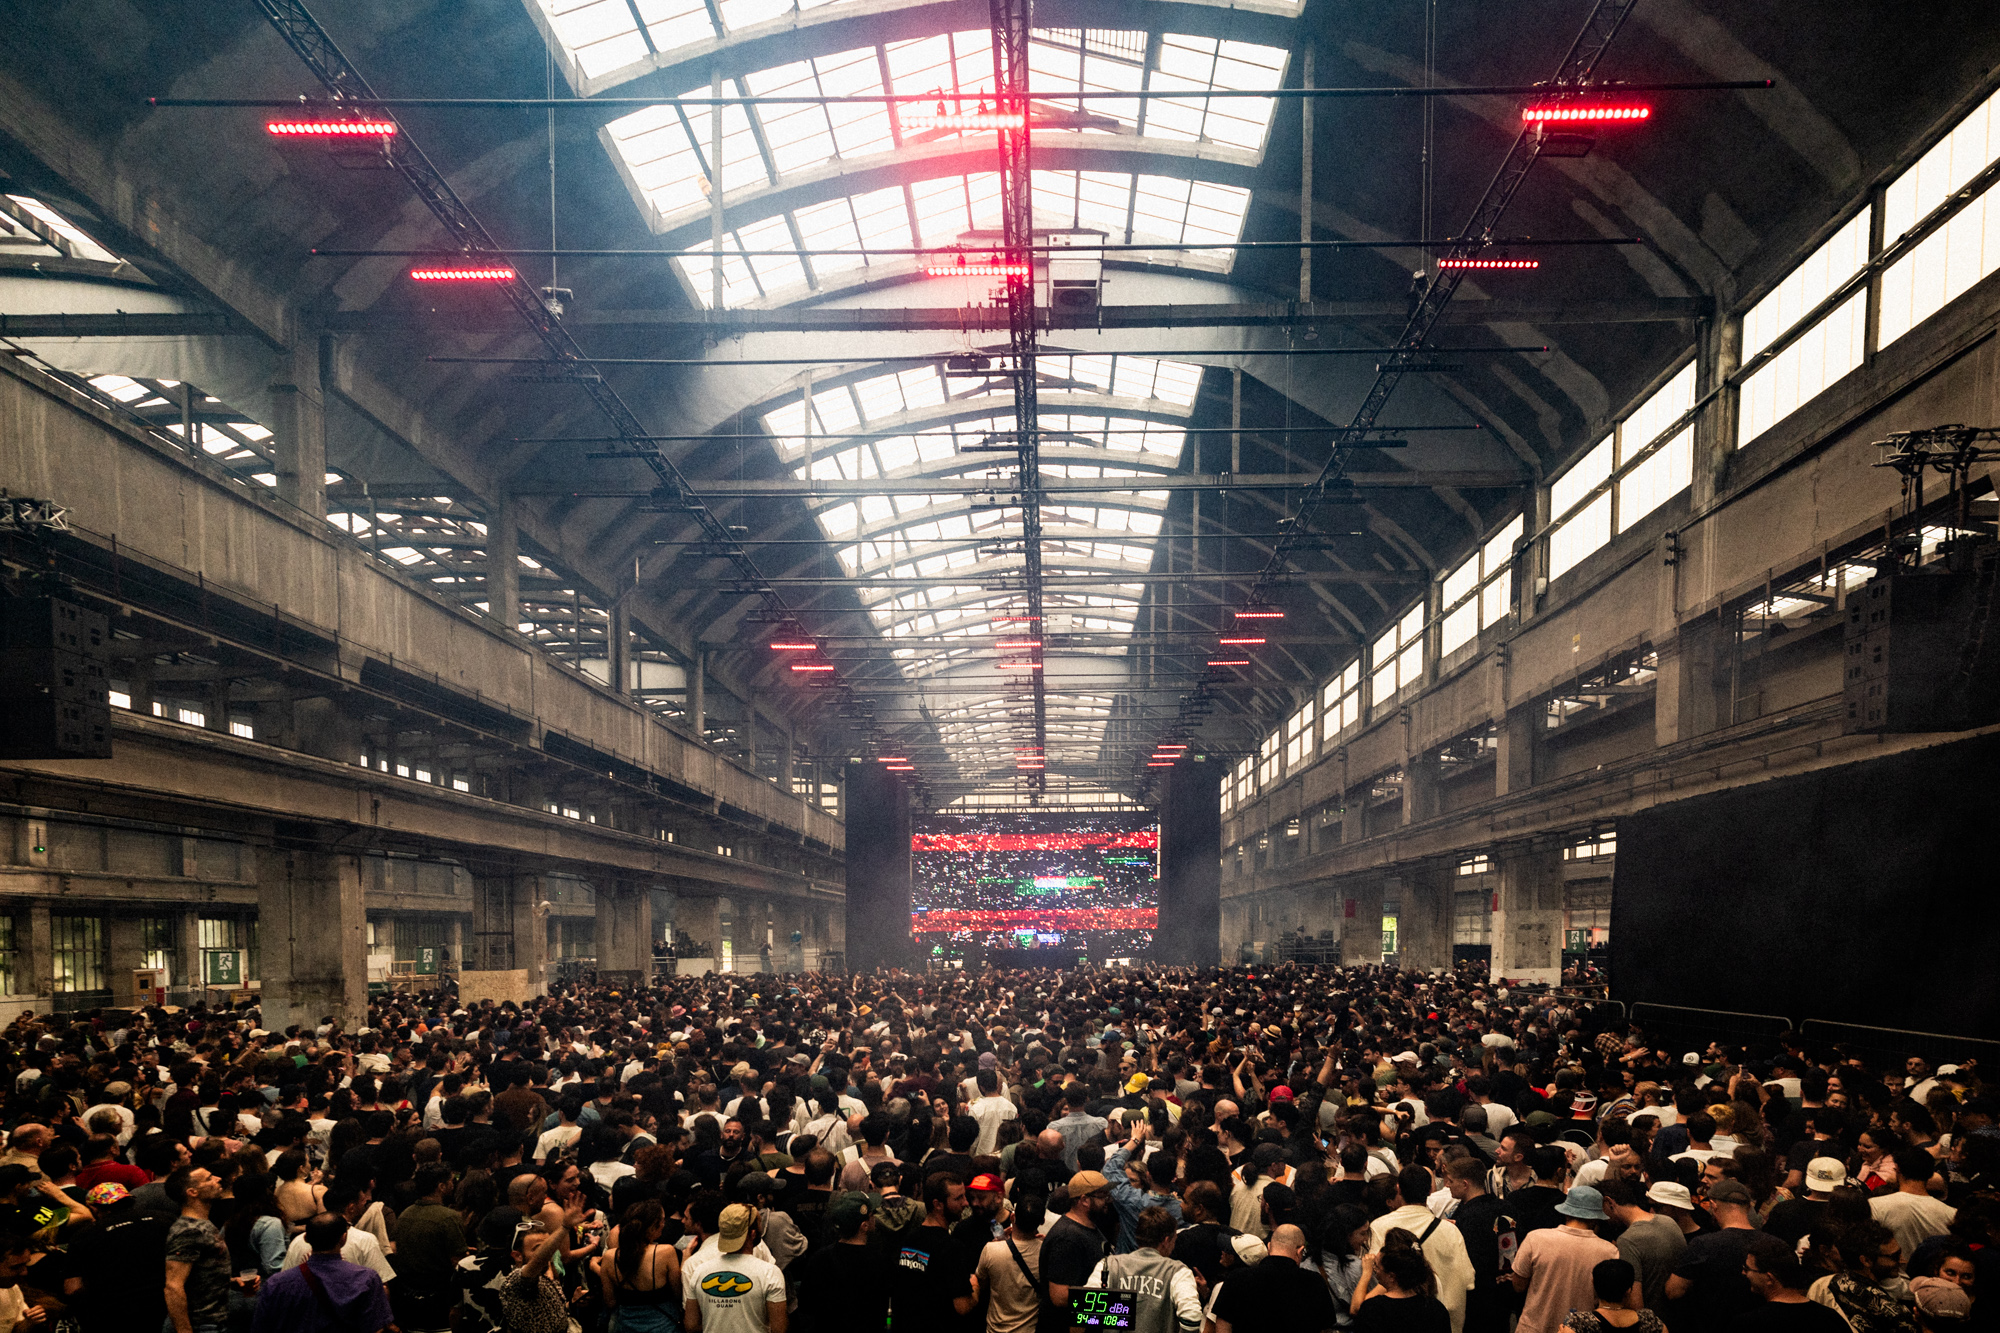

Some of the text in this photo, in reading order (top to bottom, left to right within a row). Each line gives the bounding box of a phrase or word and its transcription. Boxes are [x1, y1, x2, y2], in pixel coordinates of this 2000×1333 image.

[898, 1258, 925, 1272] atagonia
[1120, 1275, 1164, 1299] NIKE
[1084, 1292, 1108, 1313] 95
[1109, 1303, 1129, 1314] dBA
[1077, 1313, 1088, 1324] 94
[1103, 1315, 1117, 1326] 108
